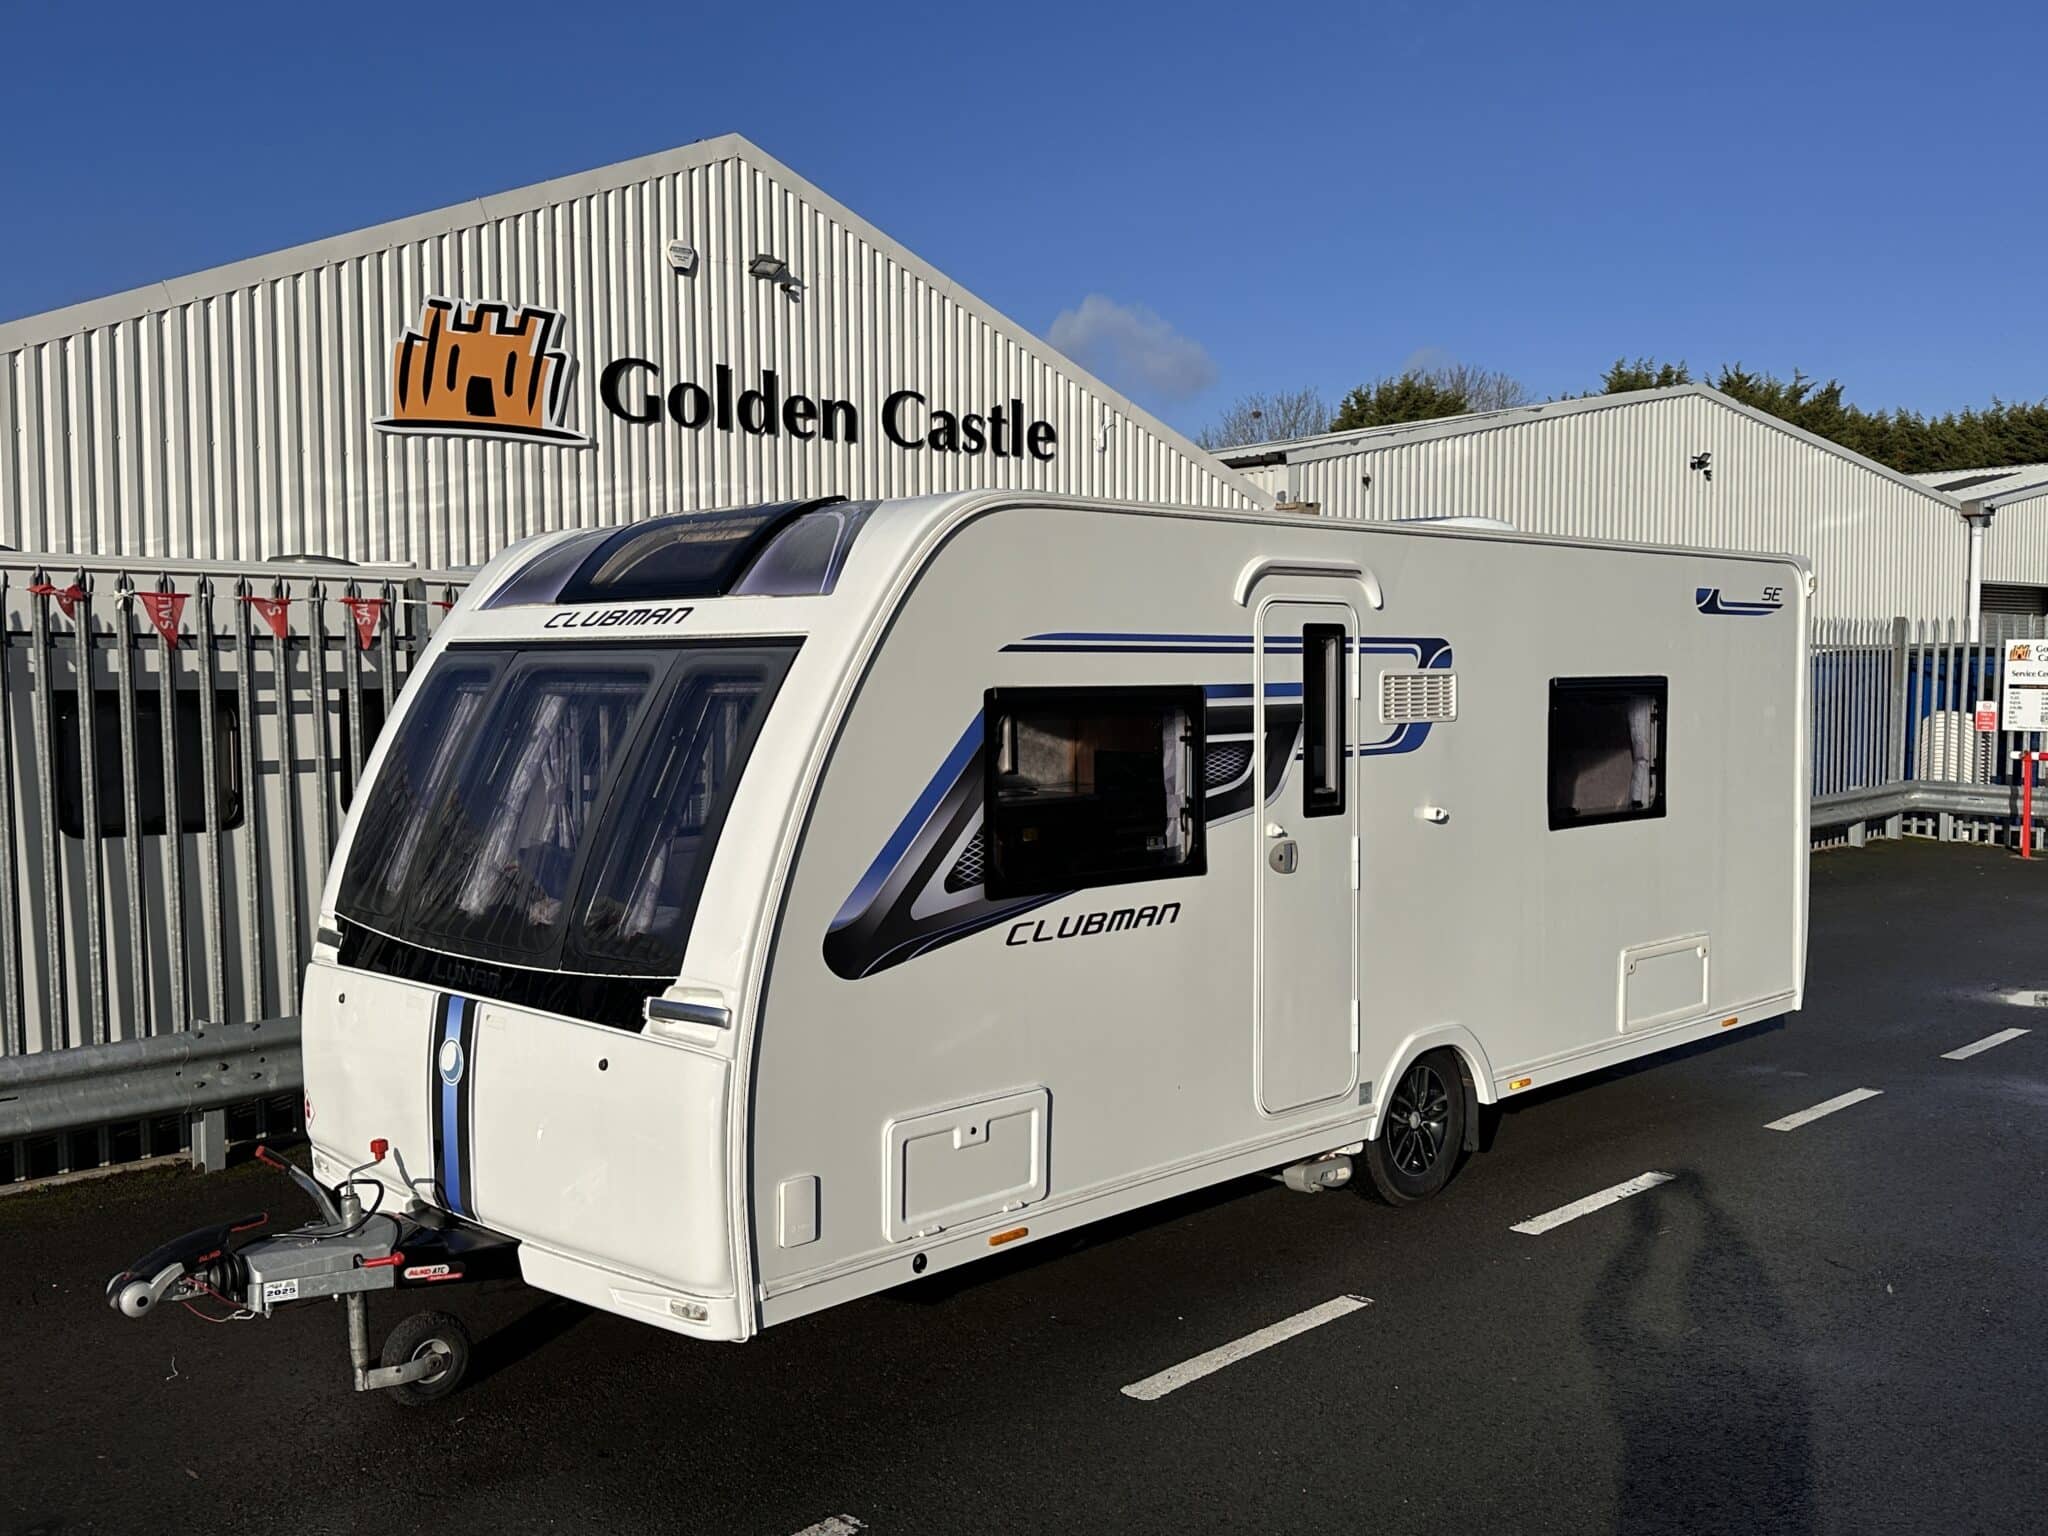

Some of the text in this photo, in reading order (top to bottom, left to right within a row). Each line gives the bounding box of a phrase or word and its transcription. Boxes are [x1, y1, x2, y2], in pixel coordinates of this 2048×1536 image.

[600, 358, 1057, 462] Golden Castle
[1761, 586, 1783, 602] SE
[544, 606, 695, 629] CLUBMAN
[1005, 902, 1182, 946] CLUBMAN
